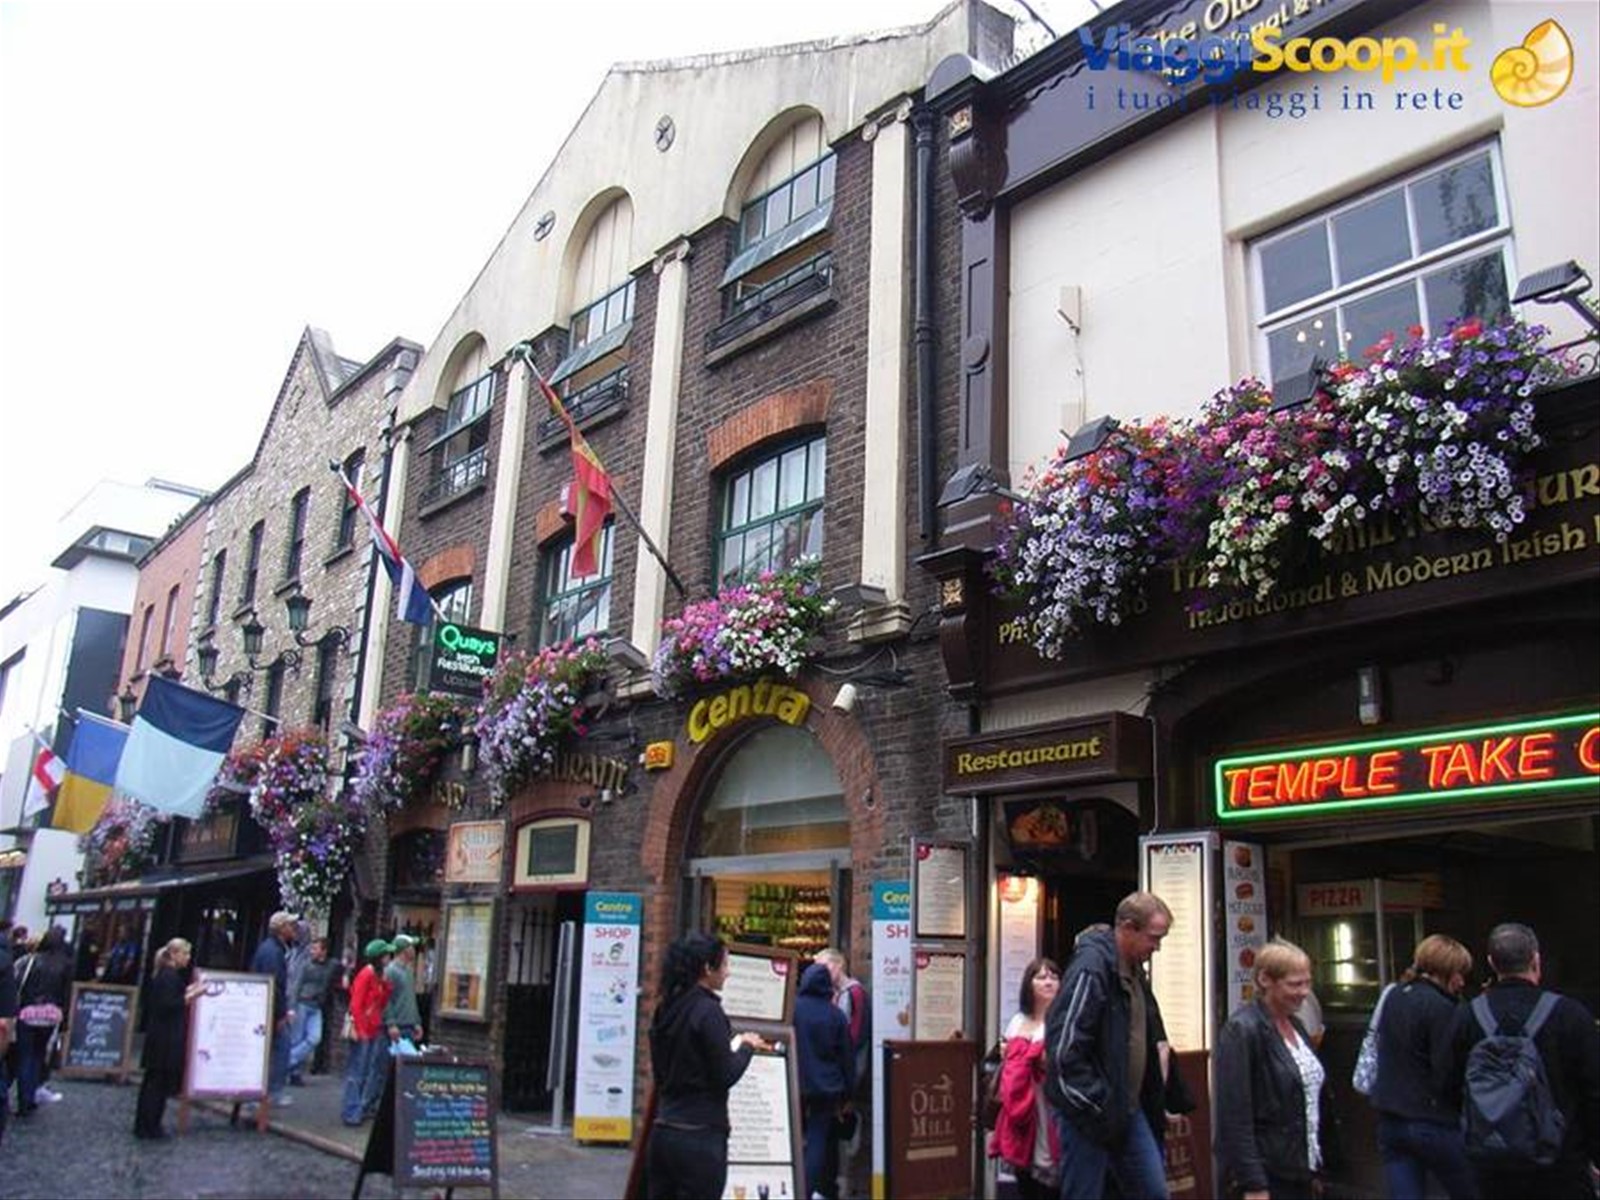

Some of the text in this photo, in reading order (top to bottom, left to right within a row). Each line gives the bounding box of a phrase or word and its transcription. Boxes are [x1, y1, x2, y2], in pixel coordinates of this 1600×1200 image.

[1341, 572, 1359, 598] &
[1366, 545, 1493, 594] Modern
[1501, 521, 1587, 566] Irish
[440, 625, 496, 655] Quays
[688, 676, 811, 743] Centra
[956, 736, 1103, 778] Restaurant
[1224, 748, 1401, 808] TEMPLE
[1420, 731, 1555, 789] TAKE
[1309, 886, 1364, 908] PIZZA
[594, 927, 632, 939] SHOP
